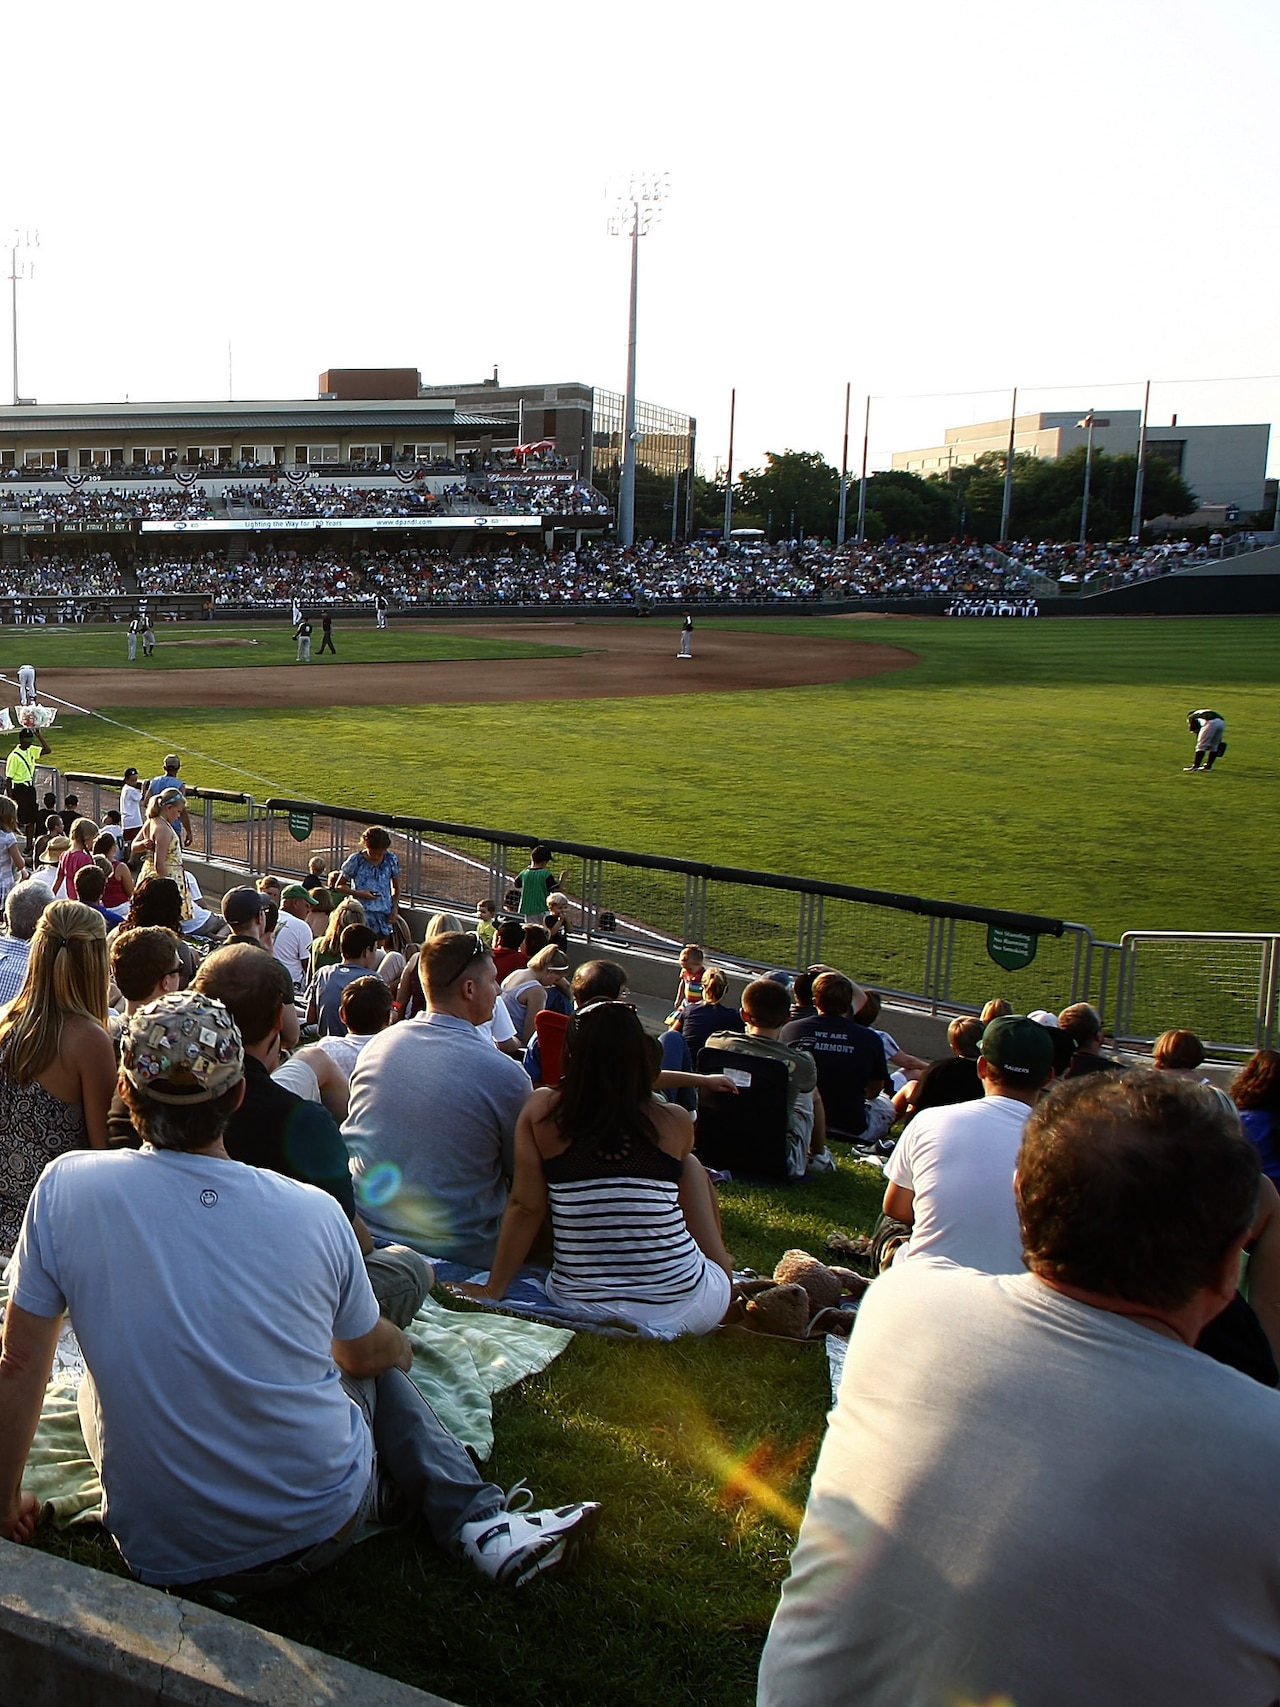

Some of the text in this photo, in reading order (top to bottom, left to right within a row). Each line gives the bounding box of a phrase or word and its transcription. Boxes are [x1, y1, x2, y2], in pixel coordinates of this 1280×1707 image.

[487, 474, 532, 482] Budweiser
[286, 521, 298, 529] Way
[1004, 931, 1030, 941] Standing
[1003, 946, 1028, 956] Smoking
